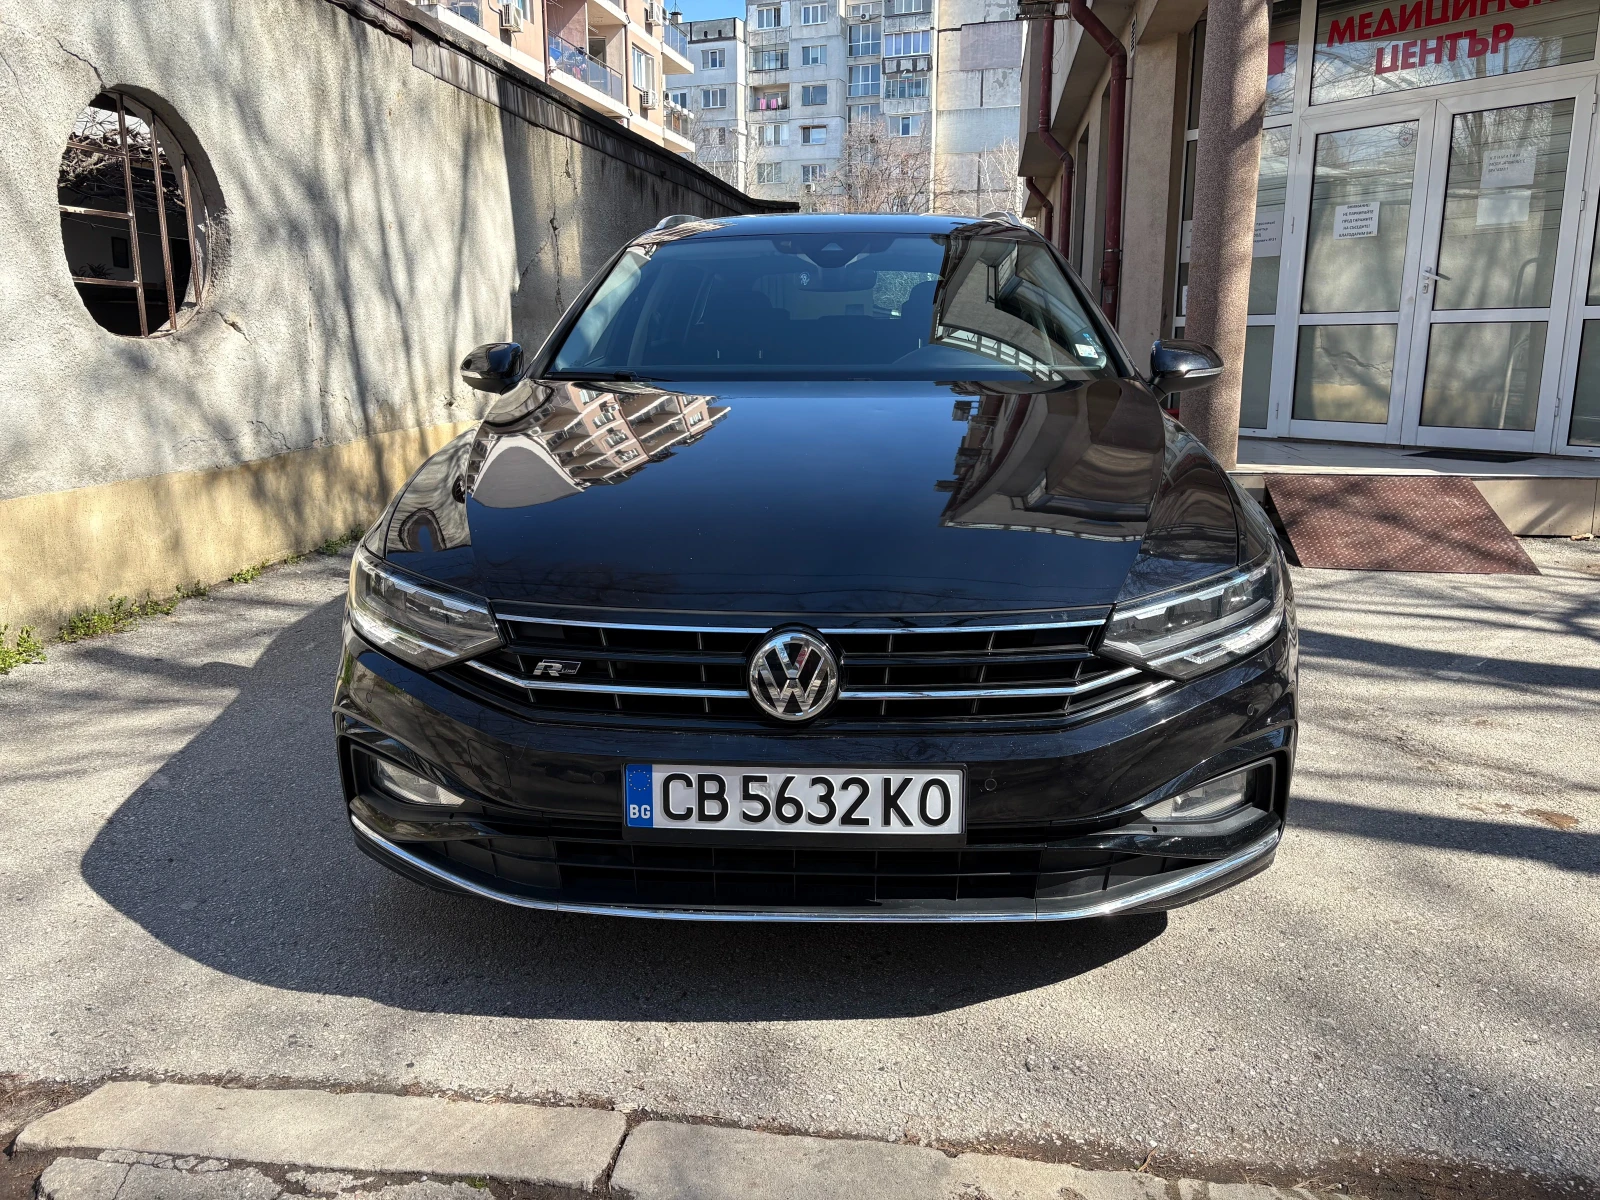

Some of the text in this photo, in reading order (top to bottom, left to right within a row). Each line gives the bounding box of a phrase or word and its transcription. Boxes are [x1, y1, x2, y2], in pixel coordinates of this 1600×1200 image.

[1327, 0, 1556, 47] МЕДИЦИН
[1375, 23, 1514, 75] ЦЕНТЪР
[533, 662, 562, 676] R
[629, 803, 651, 820] BG
[662, 772, 729, 823] CB
[742, 774, 871, 827] 5632
